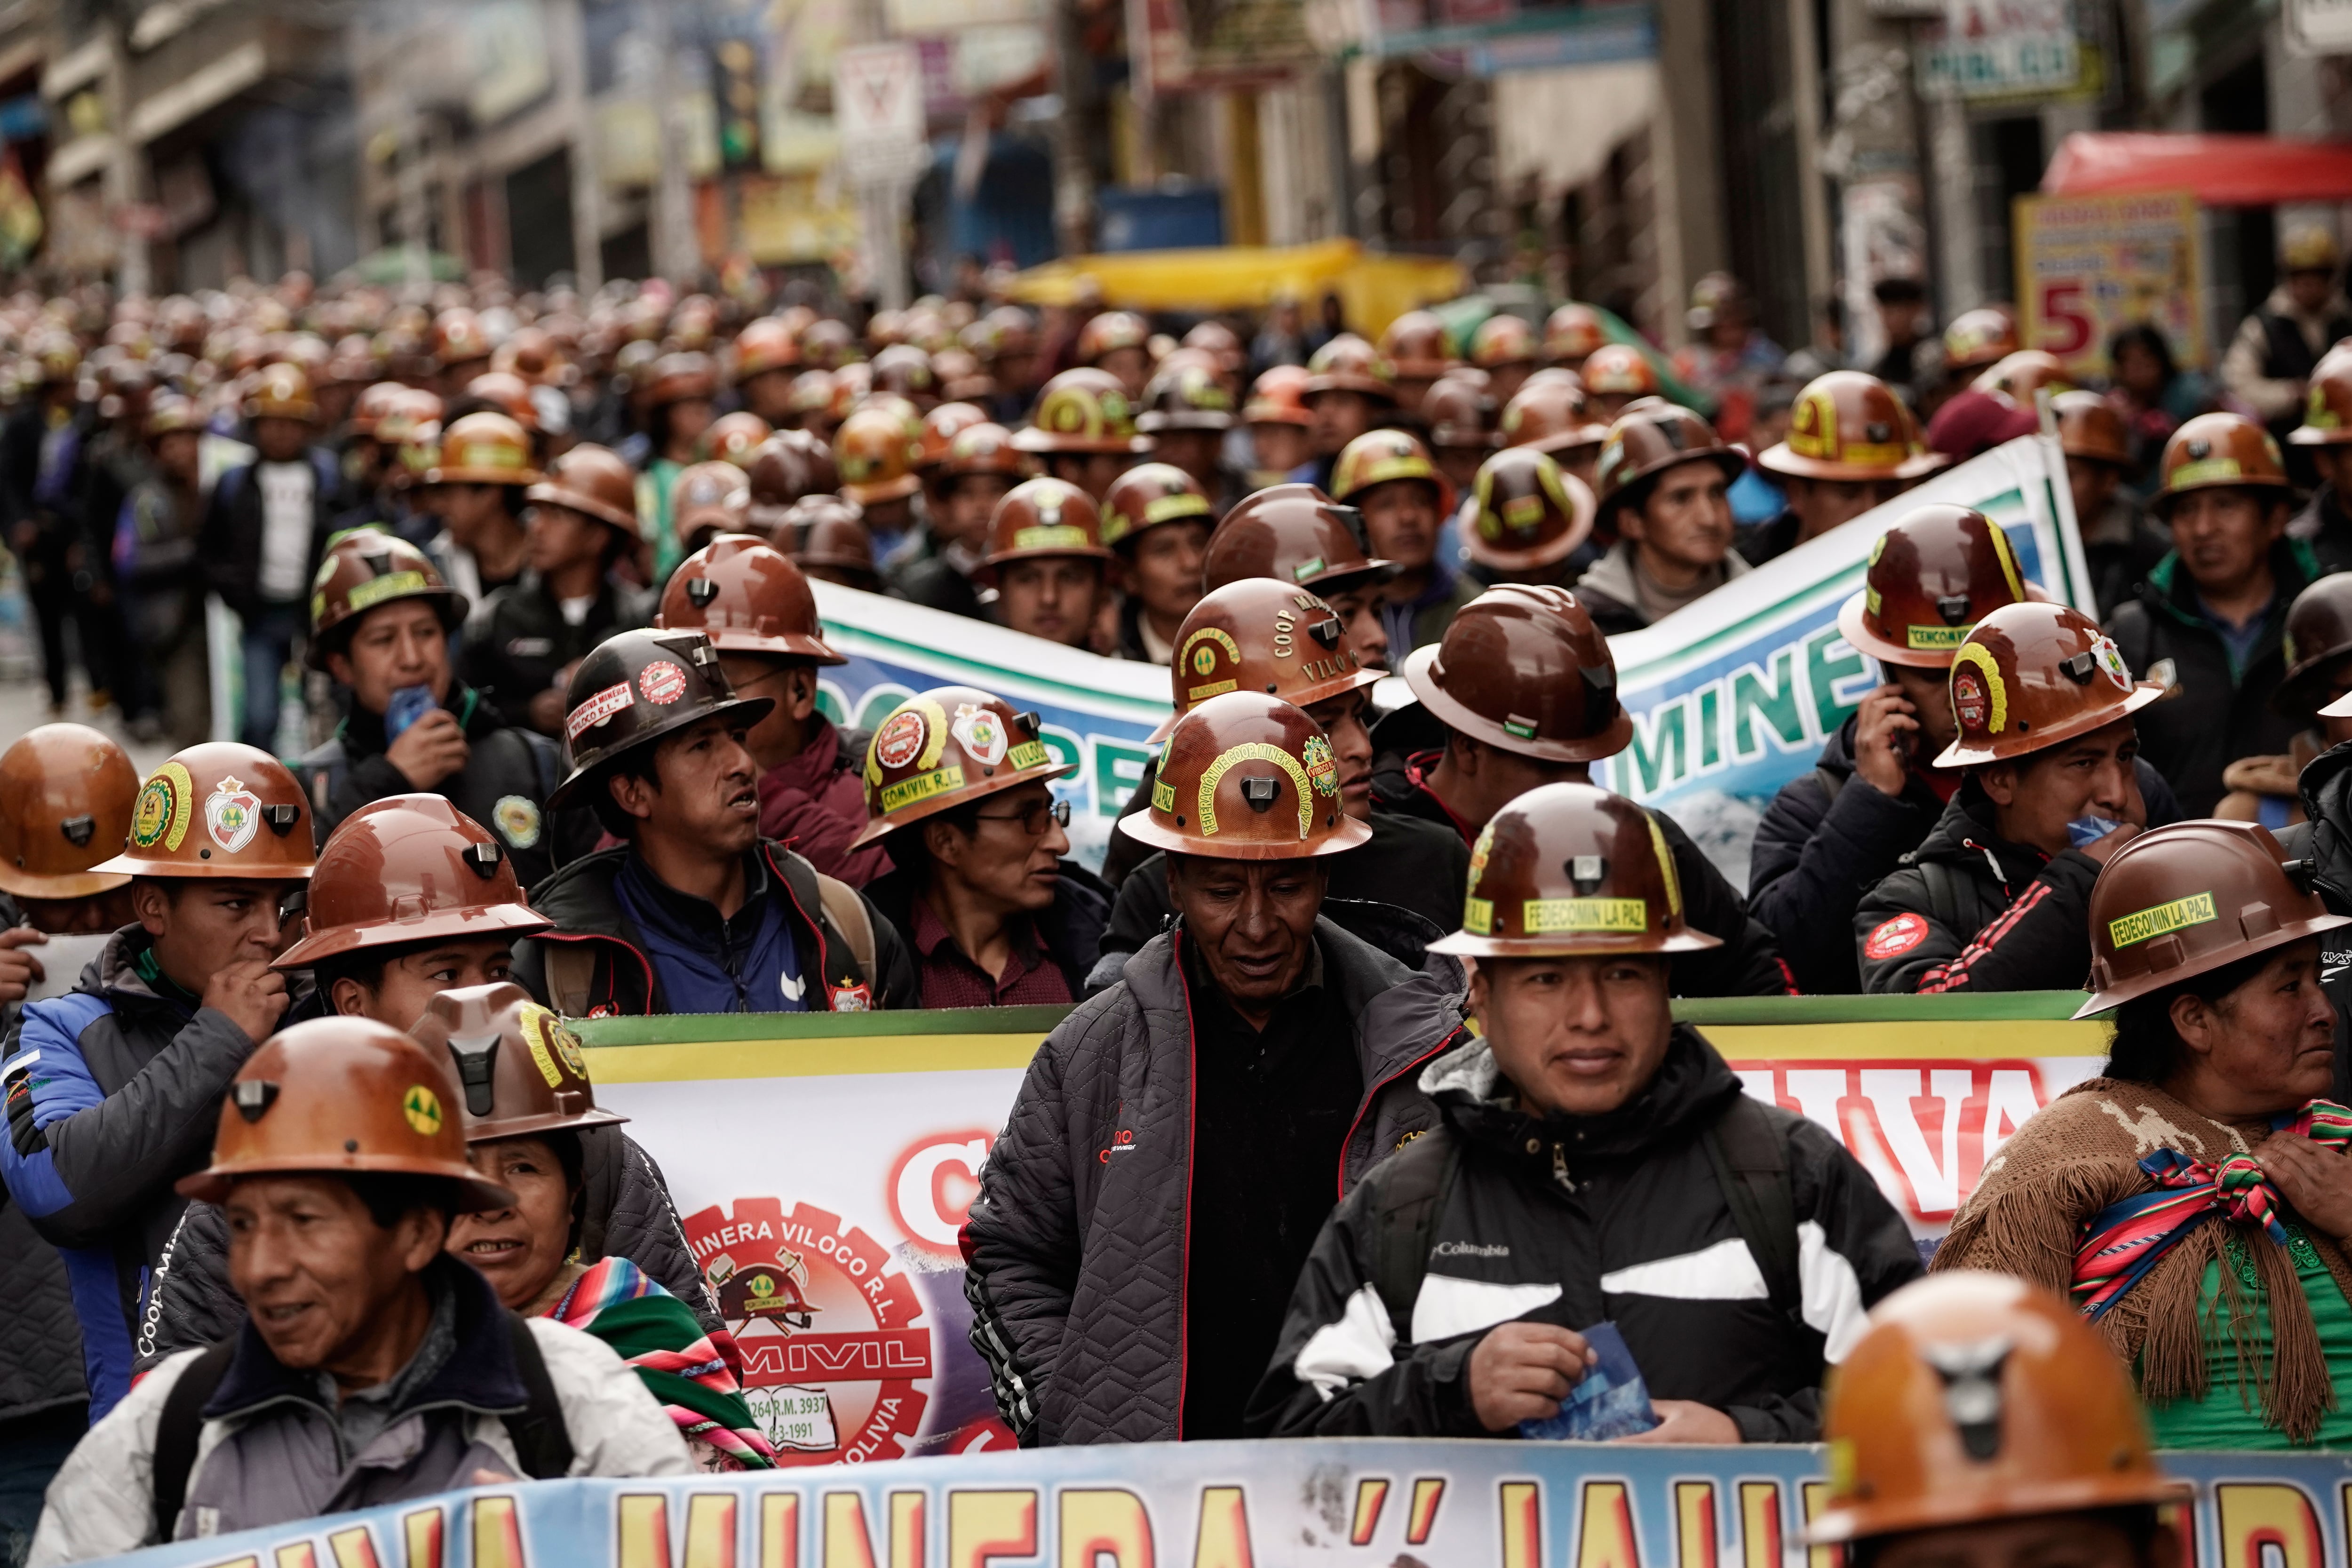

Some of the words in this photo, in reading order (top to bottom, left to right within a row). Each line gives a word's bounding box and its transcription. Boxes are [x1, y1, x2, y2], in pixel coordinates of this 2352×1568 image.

[2041, 281, 2091, 357] 5
[1274, 610, 1296, 658] COOP
[598, 686, 627, 704] MINERA
[1213, 756, 1230, 774] DE
[1227, 745, 1256, 764] COOP.
[1258, 745, 1300, 775] MINERAS
[1294, 771, 1308, 787] DE
[1310, 764, 1329, 777] VILOCO
[885, 778, 931, 807] COMIVIL
[934, 770, 961, 789] R.L.
[1156, 785, 1162, 806] LA
[1161, 787, 1173, 810] PAZ
[1299, 787, 1312, 802] LA
[1200, 768, 1218, 834] FEDERACIÓN
[1300, 802, 1312, 824] PAZ
[167, 799, 190, 850] MINERAS
[220, 822, 245, 831] OBRERA
[1529, 904, 1599, 927] FEDECOMIN
[1605, 902, 1619, 924] LA
[1621, 904, 1642, 926] PAZ
[2113, 907, 2171, 945] FEDECOMIN
[2170, 903, 2188, 925] LA
[2186, 896, 2211, 921] PAZ
[1438, 1240, 1509, 1256] Columbia
[781, 1222, 867, 1276] VILOCO
[865, 1276, 894, 1323] R.L.
[774, 1399, 798, 1416] R.M.
[799, 1396, 826, 1414] 3937
[769, 1422, 813, 1440] 6-3-1991
